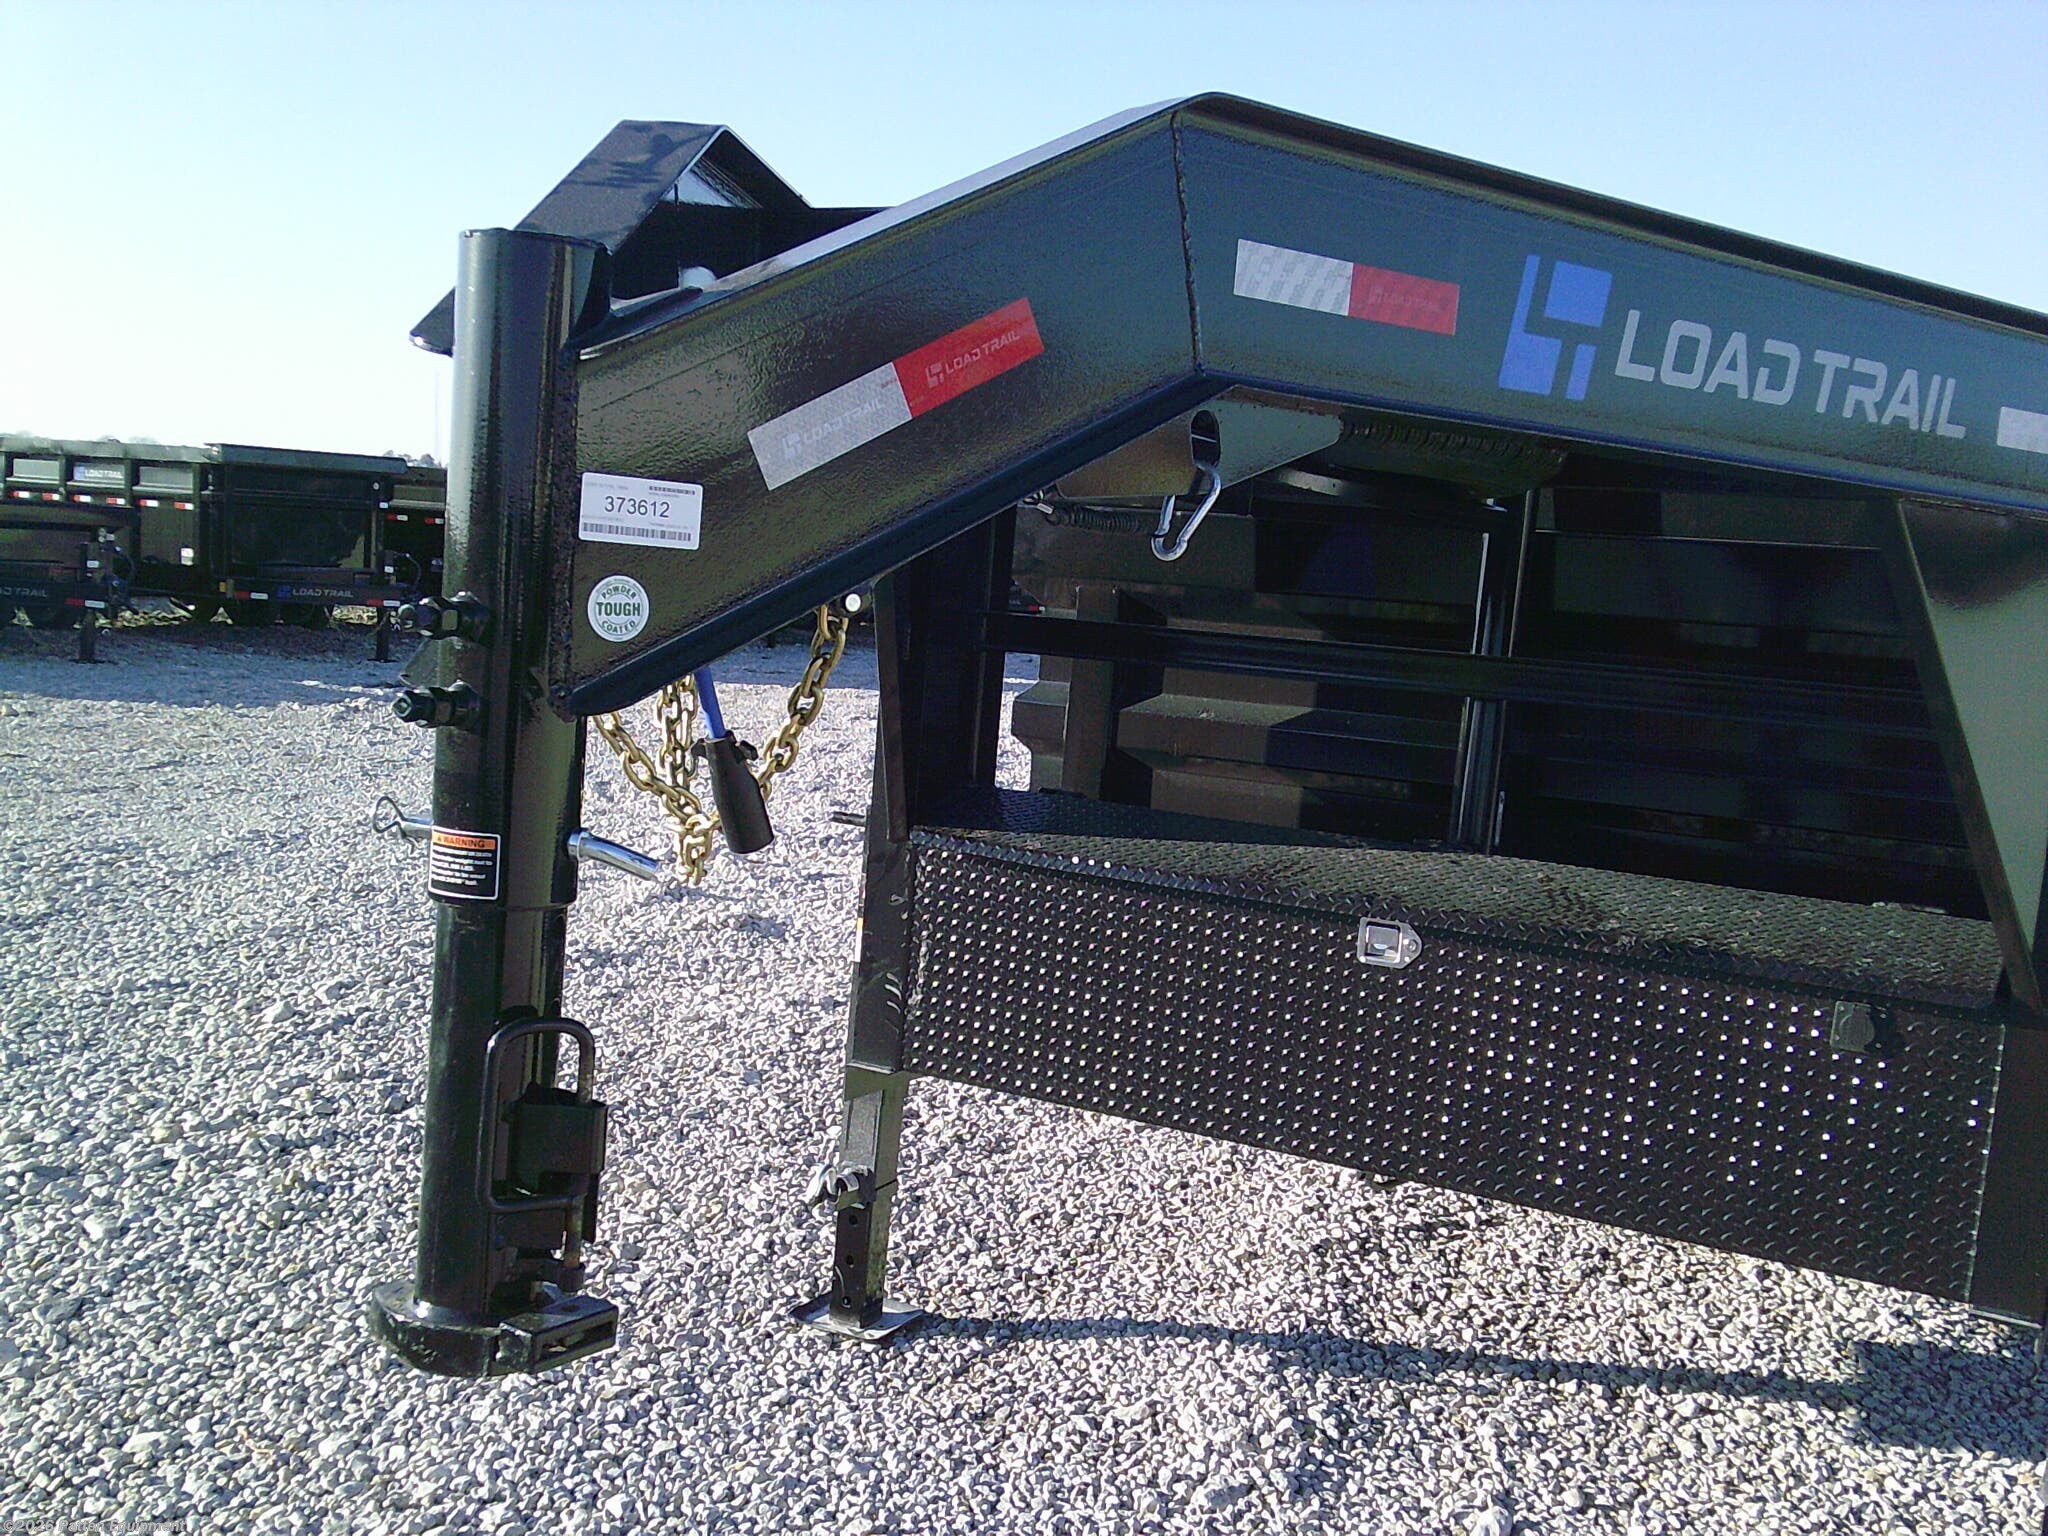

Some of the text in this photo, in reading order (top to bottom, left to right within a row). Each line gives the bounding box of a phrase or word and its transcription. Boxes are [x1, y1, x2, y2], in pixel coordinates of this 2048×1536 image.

[944, 347, 982, 375] LOAD
[982, 328, 1021, 356] TRAIL
[1808, 348, 1969, 440] TRAIL
[604, 495, 671, 518] 373612
[292, 587, 354, 598] LOAD TRAIL
[601, 584, 637, 599] POWDER
[595, 601, 641, 617] TOUGH
[601, 619, 637, 634] COATED
[443, 836, 485, 849] WARNING
